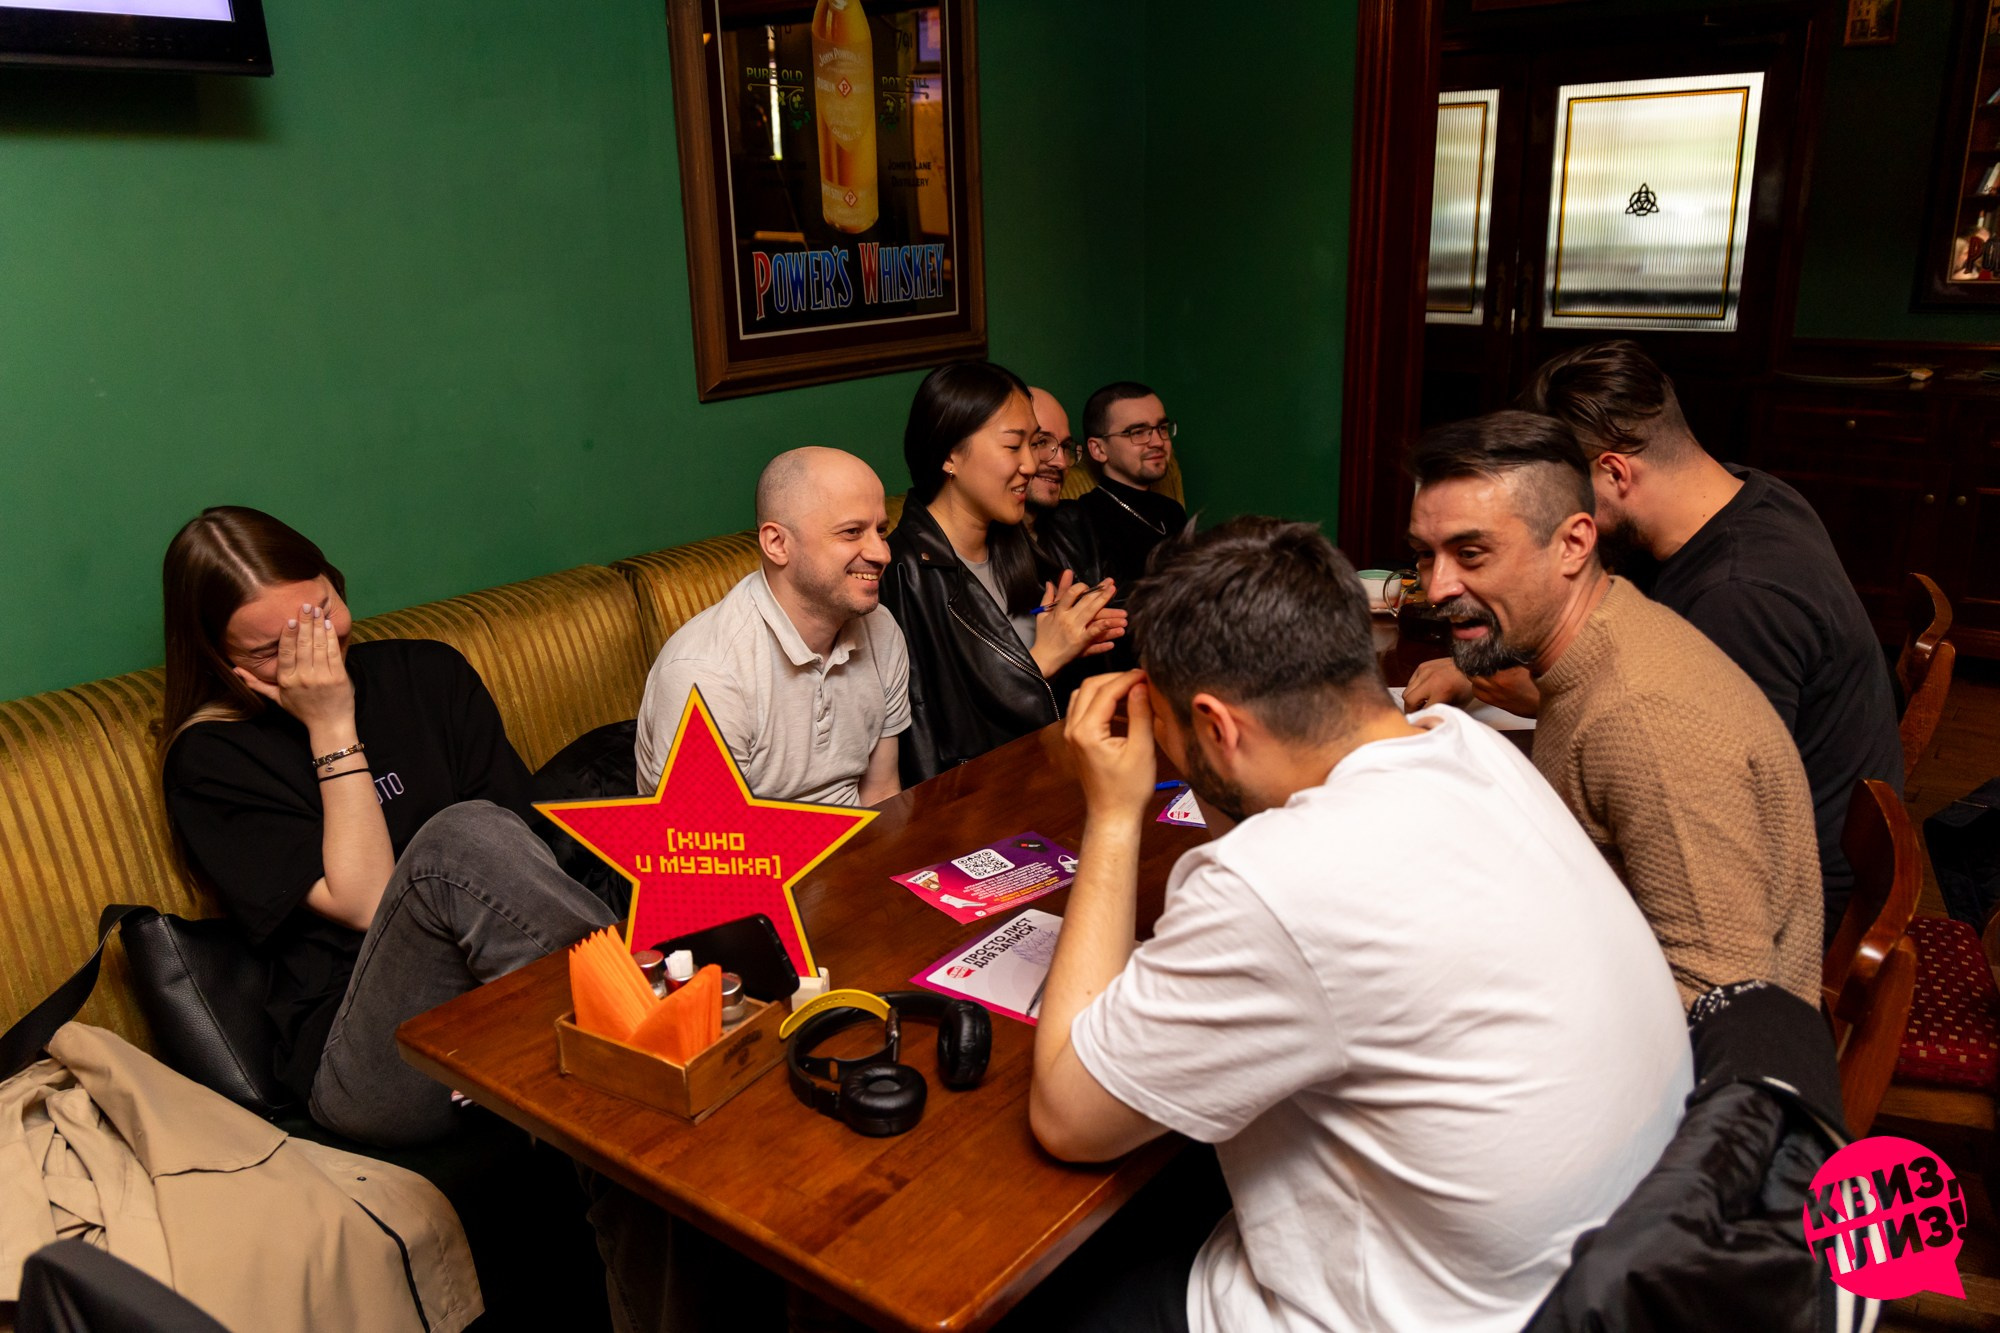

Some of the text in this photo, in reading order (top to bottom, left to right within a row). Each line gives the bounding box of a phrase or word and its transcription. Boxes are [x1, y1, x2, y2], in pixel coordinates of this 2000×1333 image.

[746, 67, 803, 82] PURE OLD
[882, 76, 929, 88] POT STILL
[913, 159, 931, 170] LANE
[752, 242, 945, 321] POWER'S WHISKEY
[962, 917, 1032, 964] ПРОСТО ЛИСТ
[973, 925, 1037, 969] ДЛЯ ЗАПИСИ
